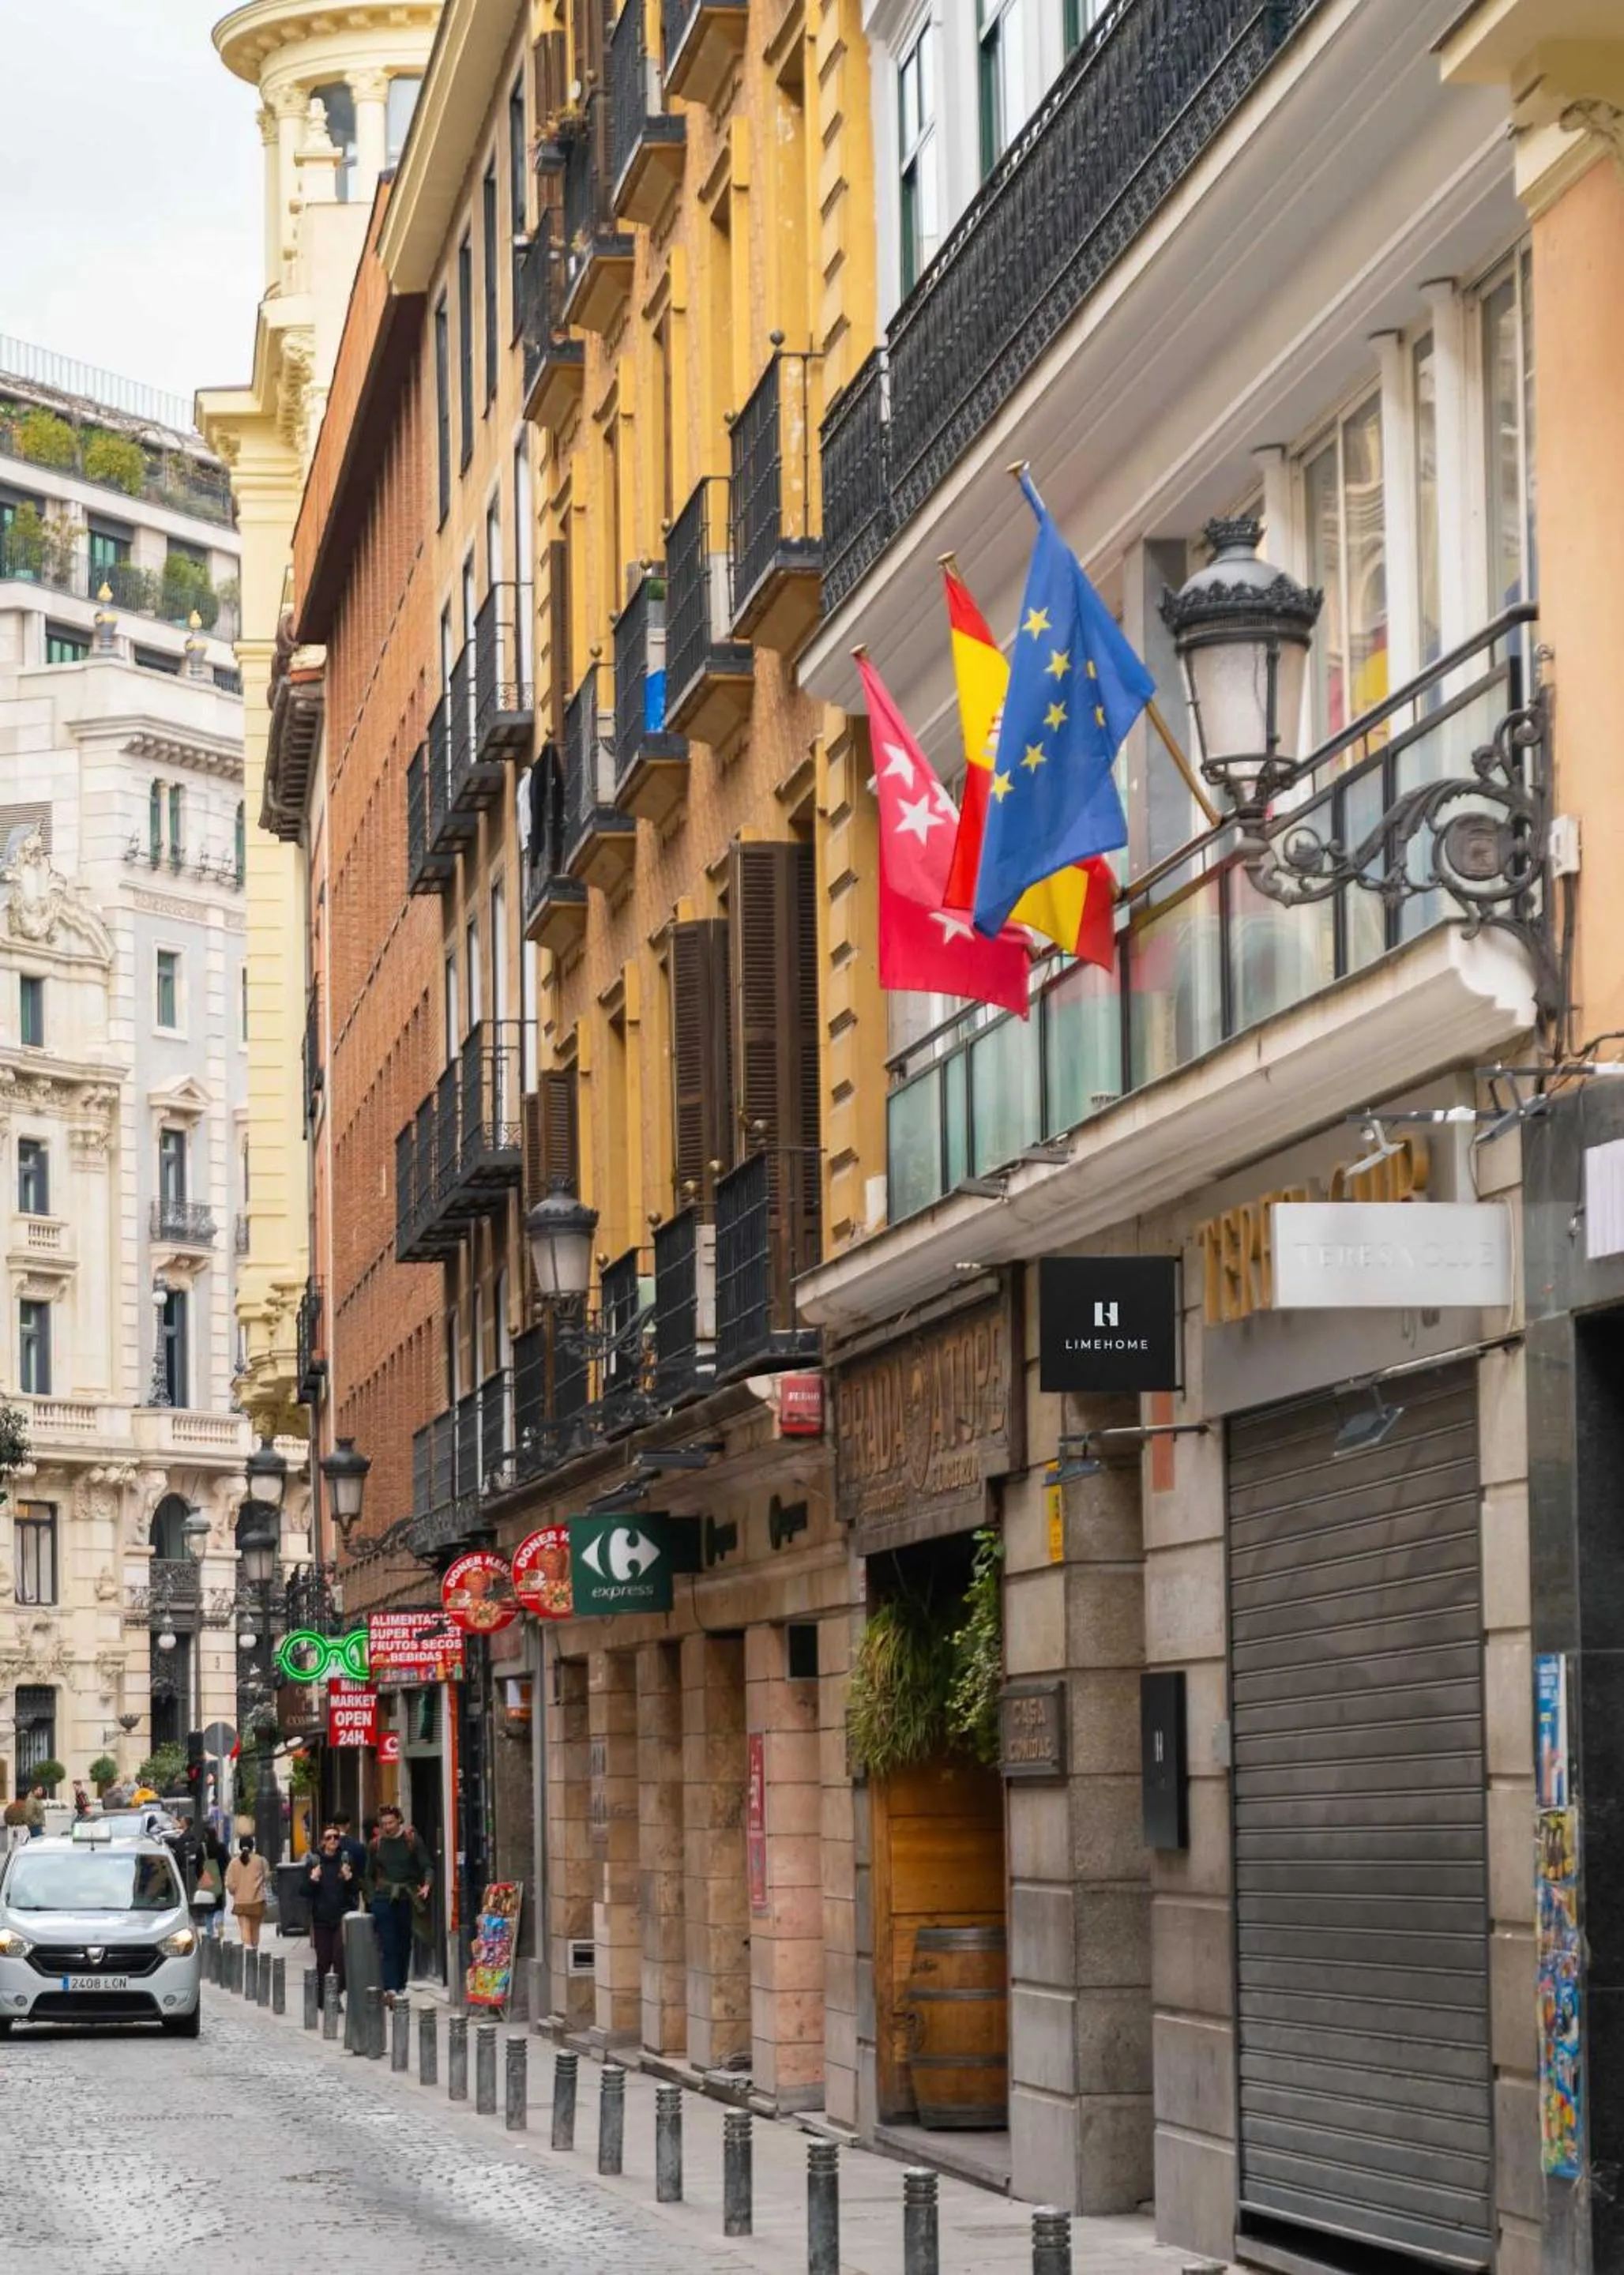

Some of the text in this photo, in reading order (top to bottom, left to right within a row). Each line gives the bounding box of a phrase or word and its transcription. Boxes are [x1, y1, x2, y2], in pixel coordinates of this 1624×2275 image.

[1066, 1339, 1148, 1349] LIMEHOME
[517, 1530, 557, 1568] DONER
[446, 1556, 483, 1588] DONER
[592, 1584, 654, 1601] express
[370, 1628, 409, 1640] SUPER
[370, 1638, 462, 1652] FRUTOS SECOS
[390, 1652, 442, 1662] BEBIDAS
[330, 1694, 376, 1707] MARKET
[335, 1710, 372, 1726] OPEN
[338, 1729, 369, 1745] 24H.
[72, 1977, 101, 1989] 2408
